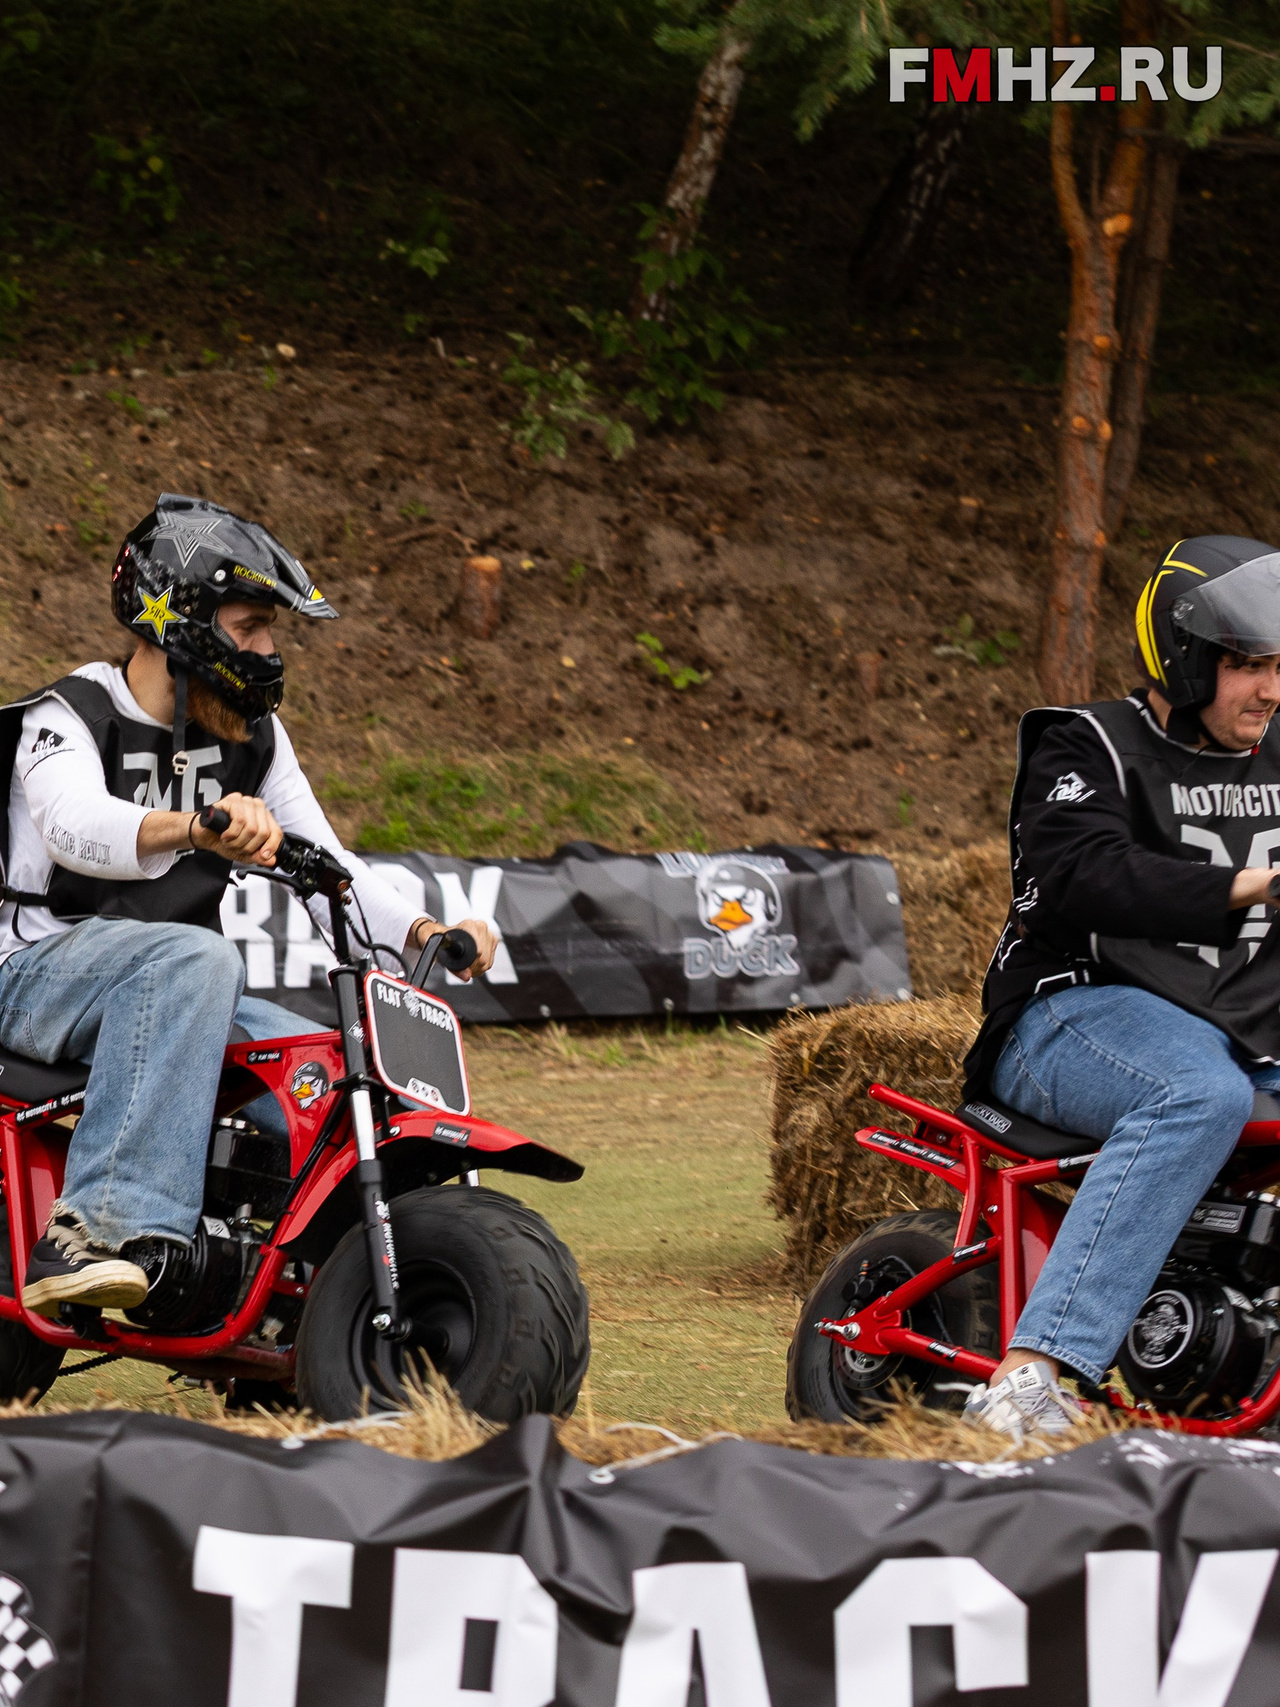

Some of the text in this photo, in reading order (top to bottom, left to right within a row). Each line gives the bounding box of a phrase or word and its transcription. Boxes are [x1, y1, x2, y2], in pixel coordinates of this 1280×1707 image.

[683, 934, 801, 980] DUCK
[377, 982, 453, 1032] FLAT TRACK
